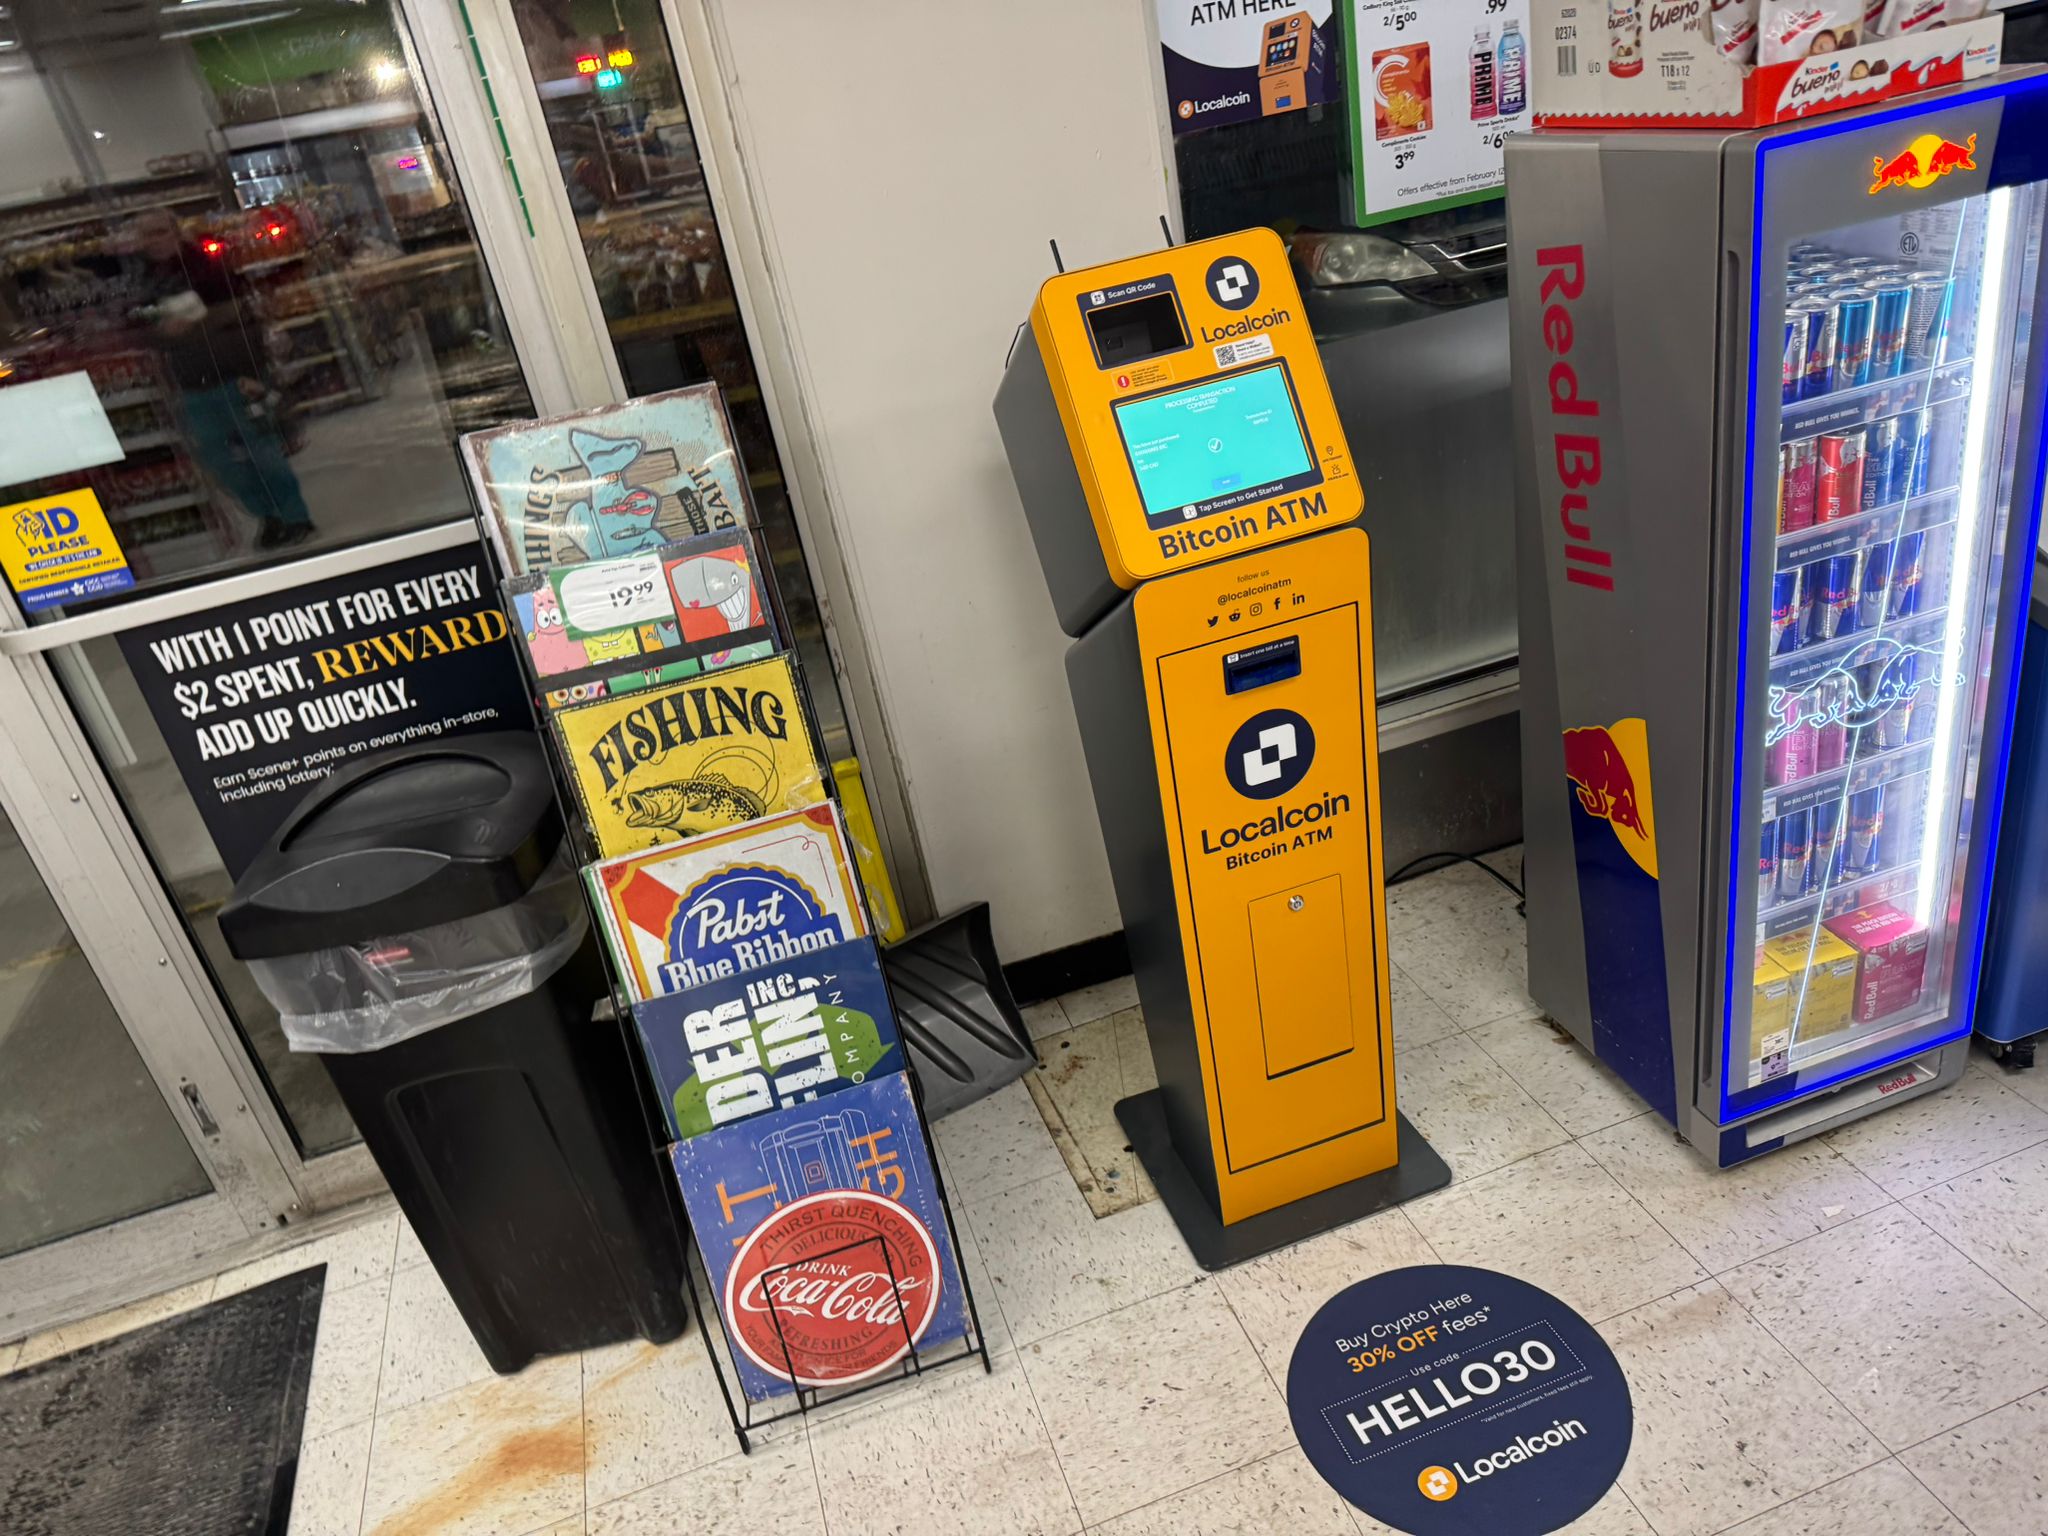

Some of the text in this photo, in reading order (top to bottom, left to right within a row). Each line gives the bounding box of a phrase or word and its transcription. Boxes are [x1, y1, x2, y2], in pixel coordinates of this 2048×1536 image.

[1190, 0, 1296, 26] ATM HE
[1555, 25, 1576, 40] 02374
[1608, 14, 1633, 30] bueno
[1650, 0, 1700, 32] bueno
[1474, 51, 1492, 106] PRIME
[1502, 47, 1522, 104] PRIME
[1682, 65, 1690, 76] 12
[1791, 69, 1840, 98] bueno
[1805, 65, 1828, 76] Kinder
[1195, 92, 1250, 114] Localcoin
[1398, 186, 1418, 197] Offers
[1420, 180, 1448, 192] effective
[1449, 177, 1465, 186] from
[1466, 169, 1496, 182] February
[1107, 281, 1156, 300] Scan QR Code
[1201, 307, 1292, 344] Localcoin
[1536, 244, 1615, 592] Red Bull
[688, 466, 737, 530] BAIT
[1199, 483, 1284, 514] Tap Screen to Get Started
[35, 507, 80, 538] ID
[1158, 491, 1328, 560] Bitcoin ATM
[28, 534, 90, 558] PLEASE
[1217, 578, 1292, 606] @localcoinatm
[1237, 573, 1259, 583] follow
[150, 629, 234, 675] WITH
[250, 601, 331, 651] POINT
[336, 587, 398, 630] FOR
[395, 566, 482, 616] EVERY
[173, 608, 512, 721] $2 SPENT, REWARD
[195, 677, 418, 762] ADD UP QUICKLY.
[589, 686, 788, 792] FISHING
[213, 707, 500, 790] Earn Scene+ points on everything in-store,
[218, 777, 286, 804] including
[1201, 792, 1350, 855] Localcoin
[1226, 826, 1333, 870] Bitcoin ATM
[686, 890, 786, 949] Pabst
[664, 925, 839, 993] Blue Ribbon
[822, 973, 866, 1085] OMPANY
[761, 1207, 825, 1251] THIRST
[830, 1204, 923, 1269] QUENCHING
[791, 1227, 869, 1256] DELICIOUS
[796, 1261, 853, 1277] DRINK
[739, 1262, 926, 1326] Coca-Cola
[1335, 1291, 1473, 1353] Buy Crypto Here
[1346, 1344, 1396, 1374] 30%
[1396, 1325, 1439, 1353] OFF
[1409, 1352, 1460, 1378] Use code
[1346, 1340, 1556, 1445] HELLO30
[1453, 1419, 1588, 1484] Localcoin
